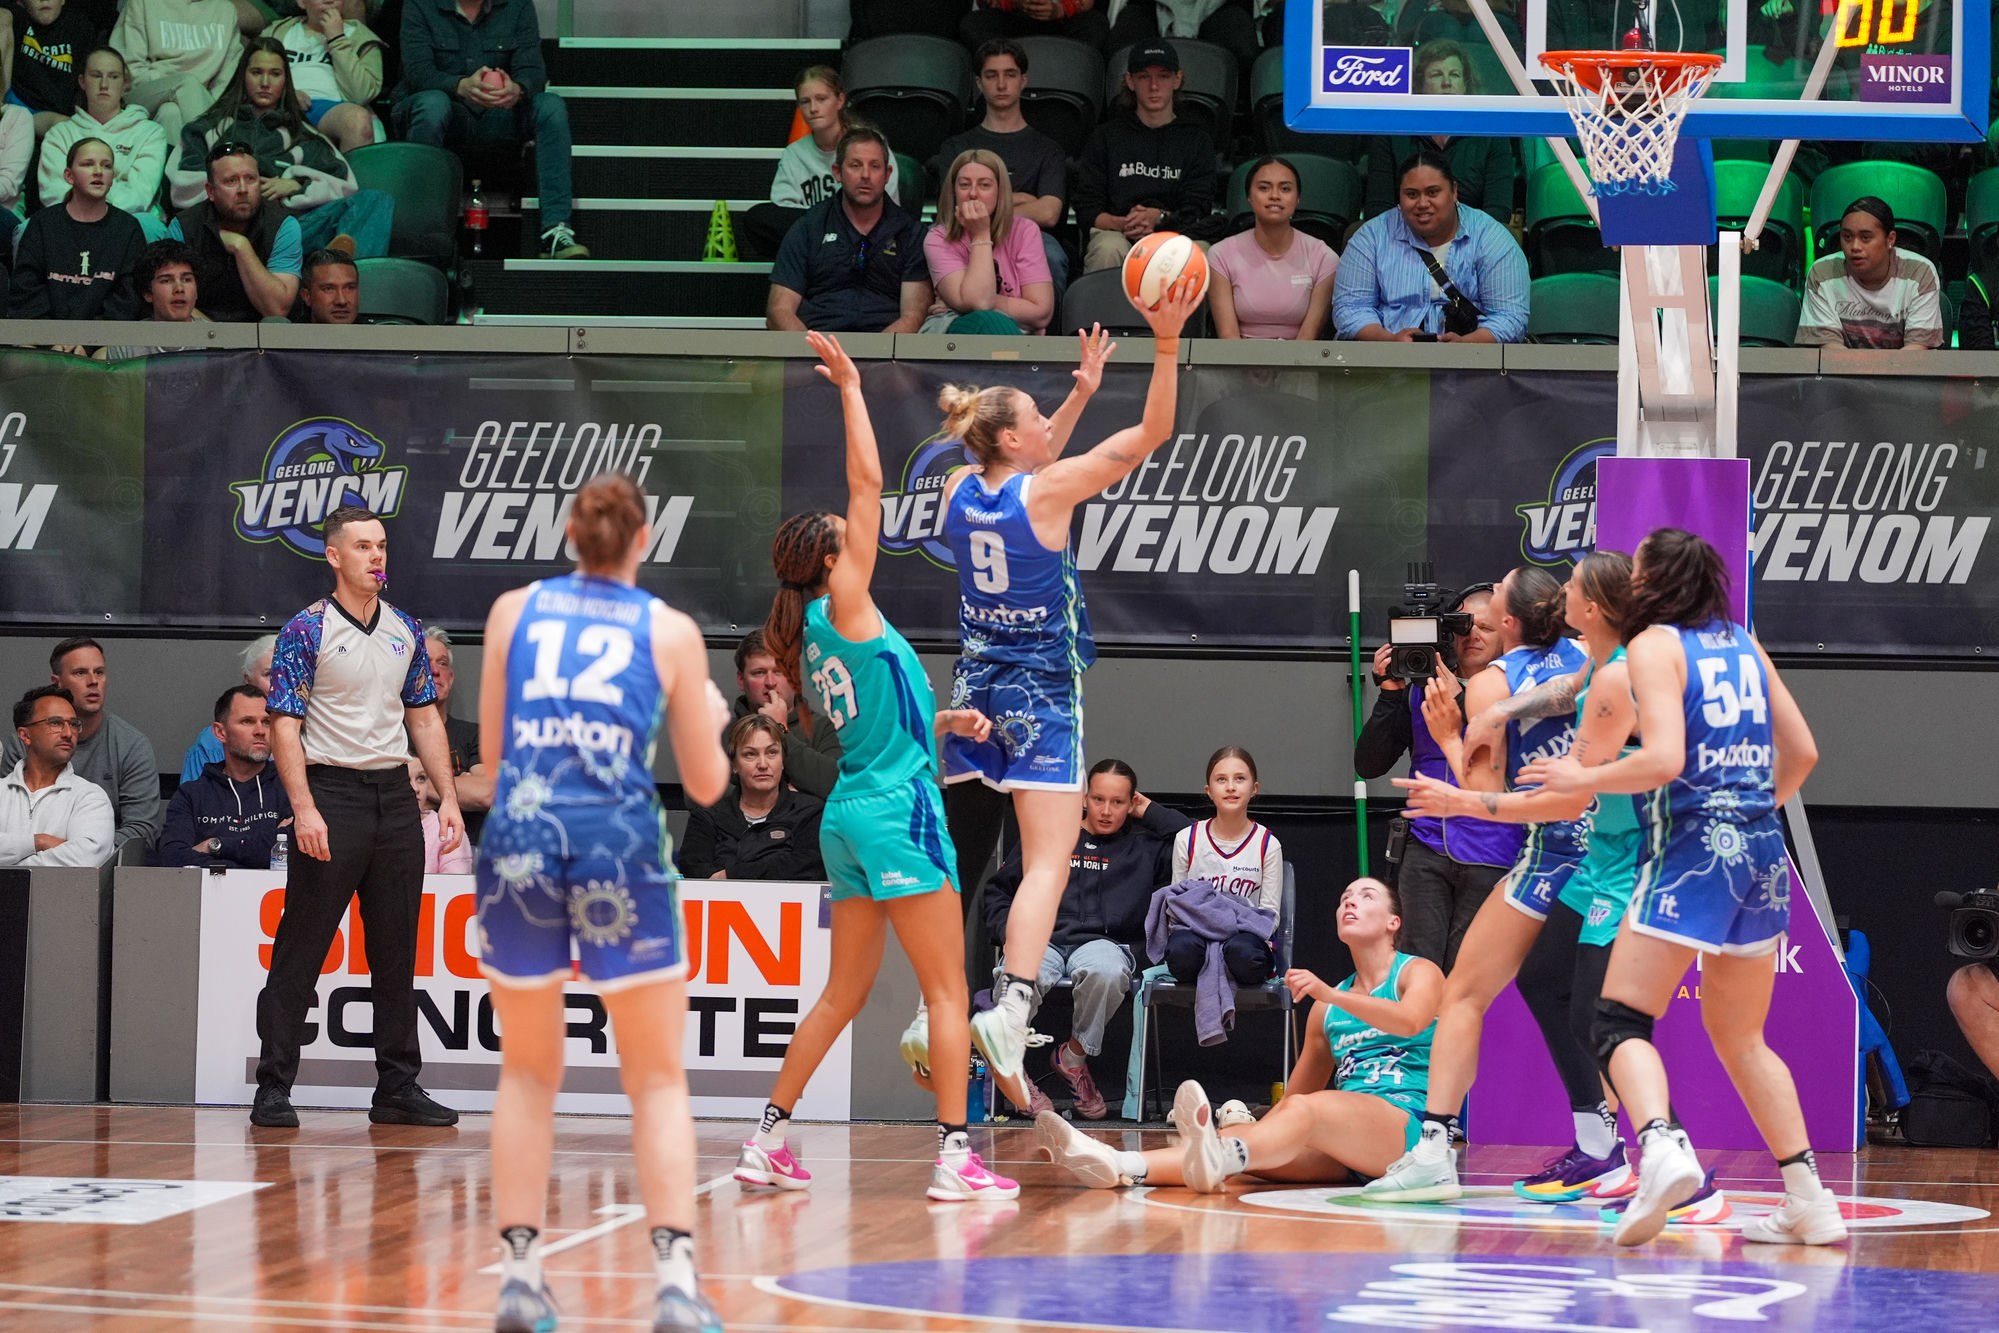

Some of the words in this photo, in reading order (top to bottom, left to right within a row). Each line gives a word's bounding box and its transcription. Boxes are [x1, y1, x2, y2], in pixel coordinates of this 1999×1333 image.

[1329, 55, 1404, 86] Ford
[1867, 65, 1945, 83] MINOR
[275, 461, 336, 480] GEELONG
[459, 420, 663, 490] GEELONG
[1752, 440, 1959, 512] GEELONG
[235, 471, 404, 528] VENOM
[432, 491, 695, 563] VENM
[964, 506, 1003, 525] SHARP
[969, 530, 1009, 594] 9
[1076, 503, 1340, 574] VENOM
[522, 618, 635, 707] 12
[1696, 654, 1767, 728] 54
[811, 656, 859, 731] 29
[512, 711, 633, 758] buxton
[197, 815, 232, 824] TOMMY
[244, 811, 278, 825] HILFIGE
[1363, 1059, 1405, 1085] 34
